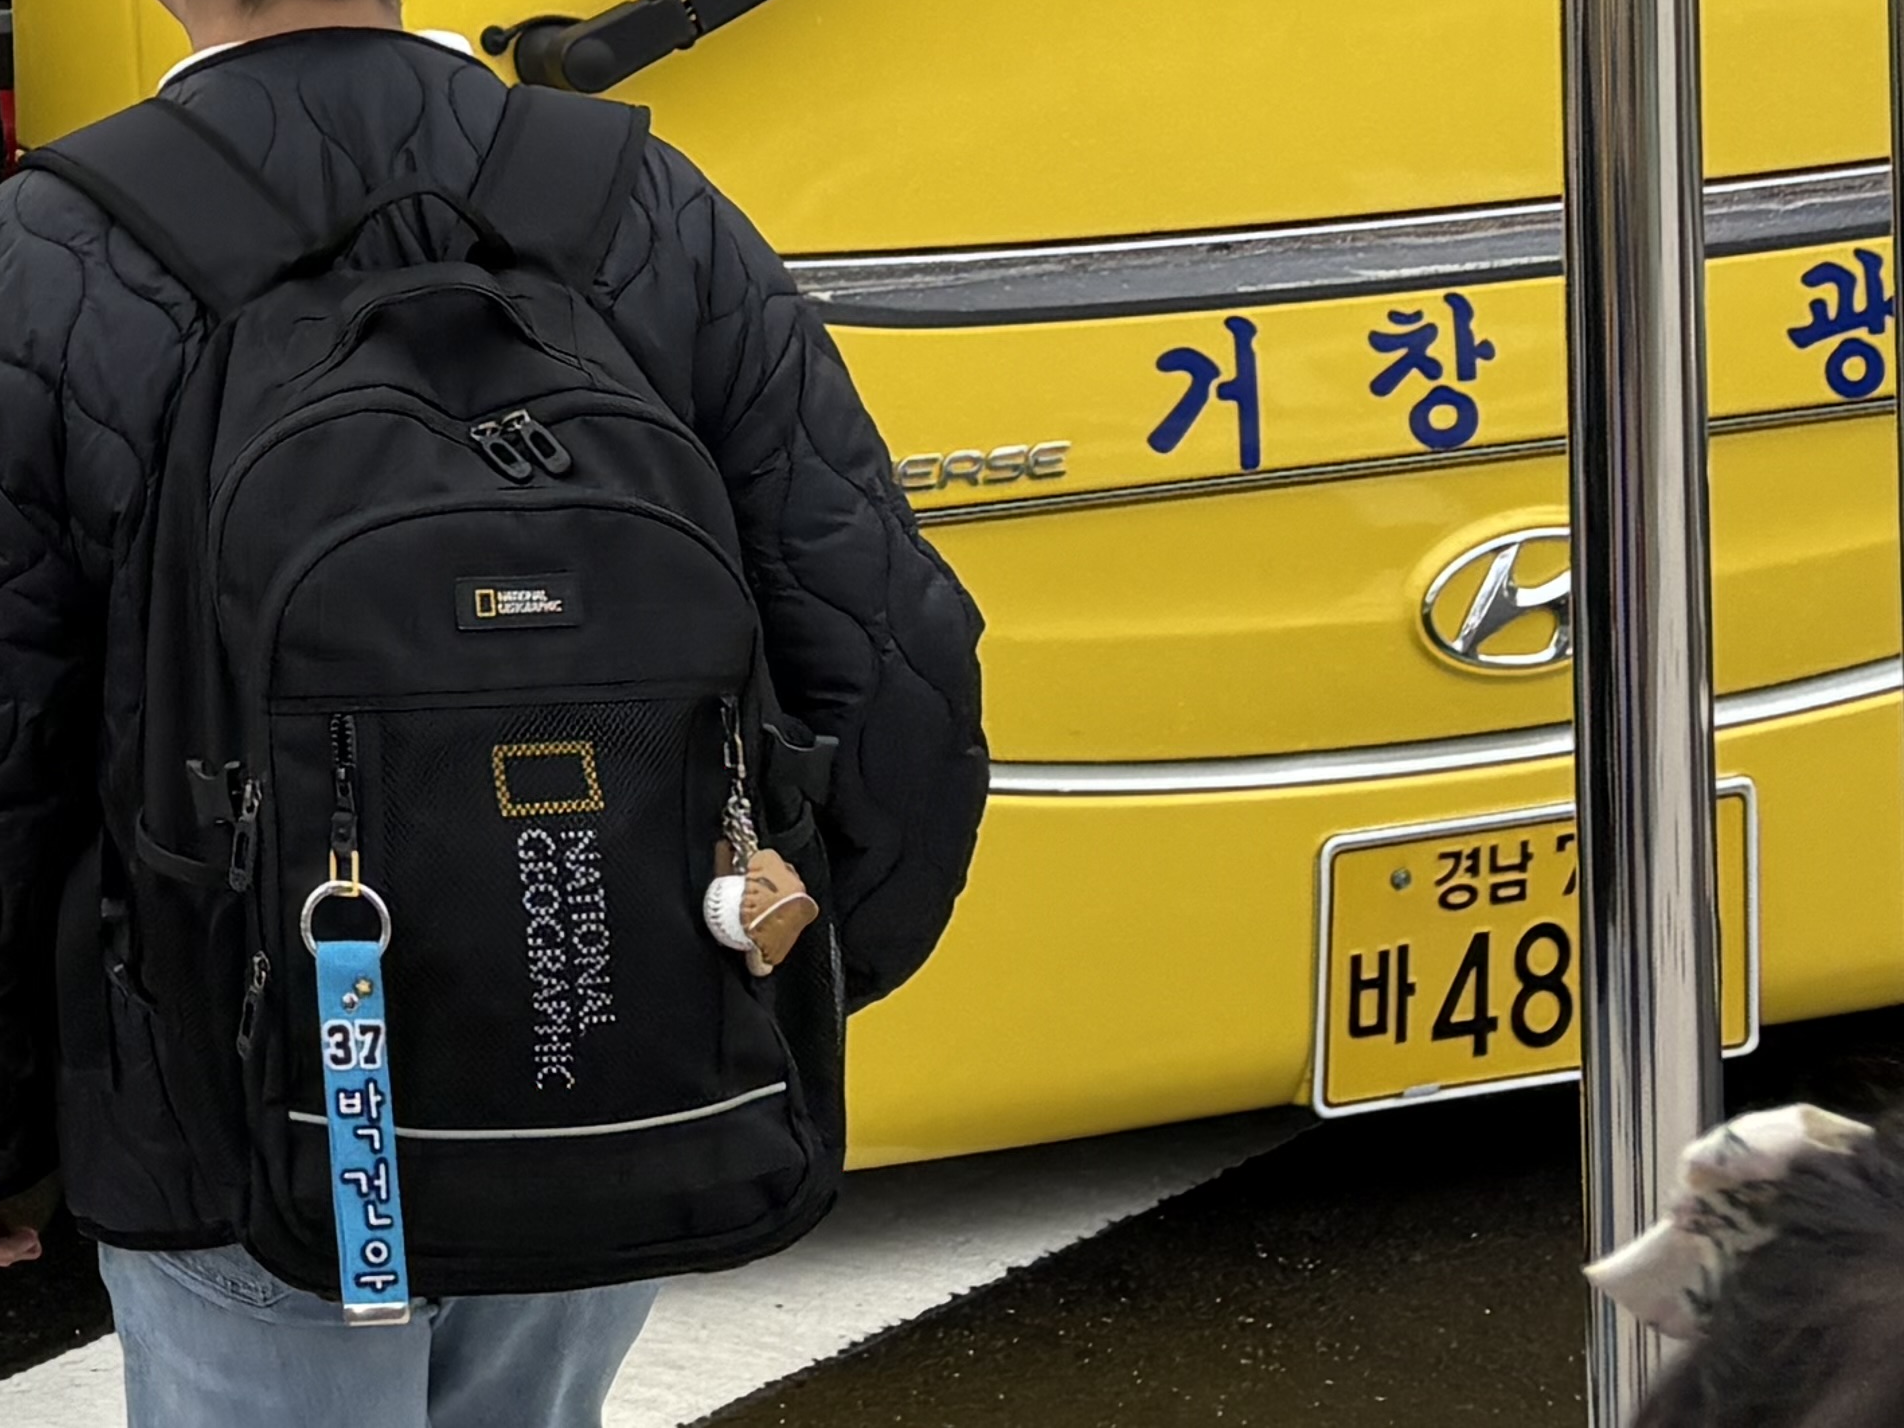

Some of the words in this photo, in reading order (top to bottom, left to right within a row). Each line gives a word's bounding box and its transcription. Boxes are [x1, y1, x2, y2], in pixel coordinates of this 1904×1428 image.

[896, 440, 1072, 491] ERSE
[559, 828, 617, 1038] NATIONAL
[1435, 840, 1534, 911] 경남
[516, 827, 576, 1091] GEOGRAPHIC
[322, 1018, 386, 1071] 37
[337, 1077, 397, 1295] 박건우
